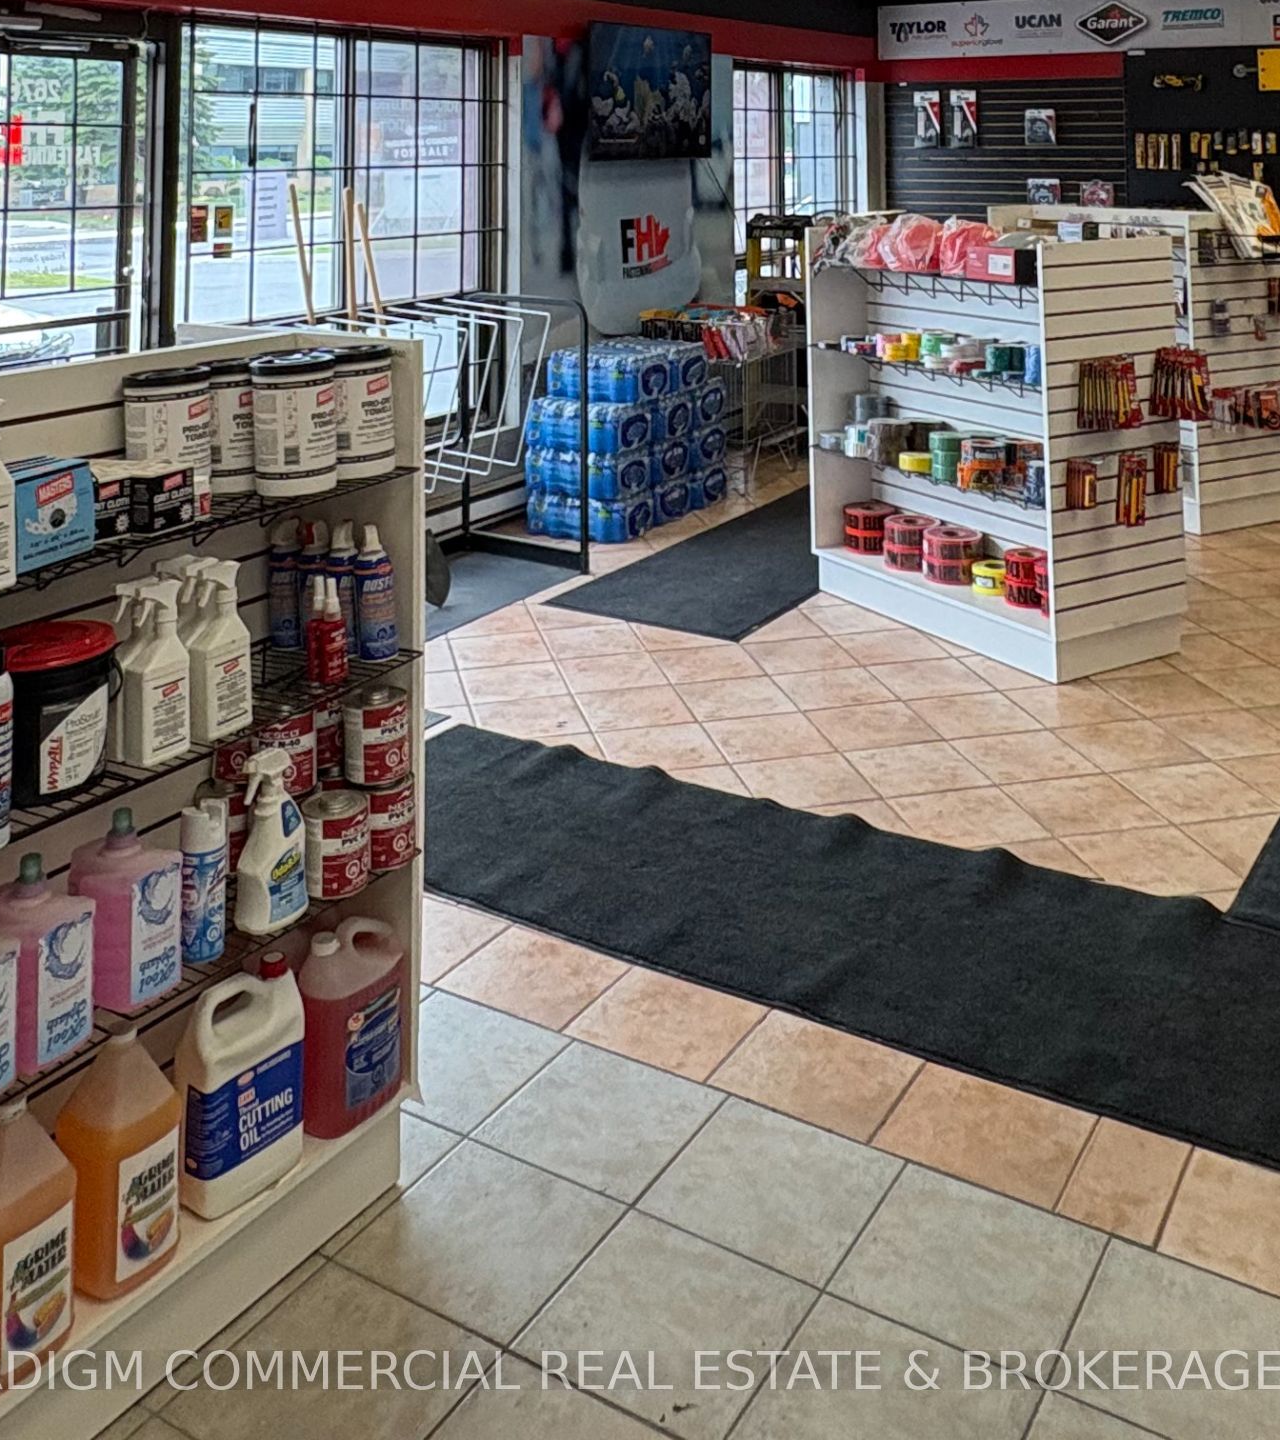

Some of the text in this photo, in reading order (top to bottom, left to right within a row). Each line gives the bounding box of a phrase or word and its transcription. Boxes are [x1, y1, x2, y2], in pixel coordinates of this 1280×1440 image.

[1014, 13, 1062, 29] UCAN
[1086, 14, 1136, 30] Garant
[1162, 7, 1222, 23] TREMCO
[889, 20, 947, 43] TAYLOR
[36, 473, 73, 504] MASTERS
[258, 728, 300, 740] NESCO
[238, 1087, 294, 1134] CUTTING
[239, 1128, 261, 1152] OIL
